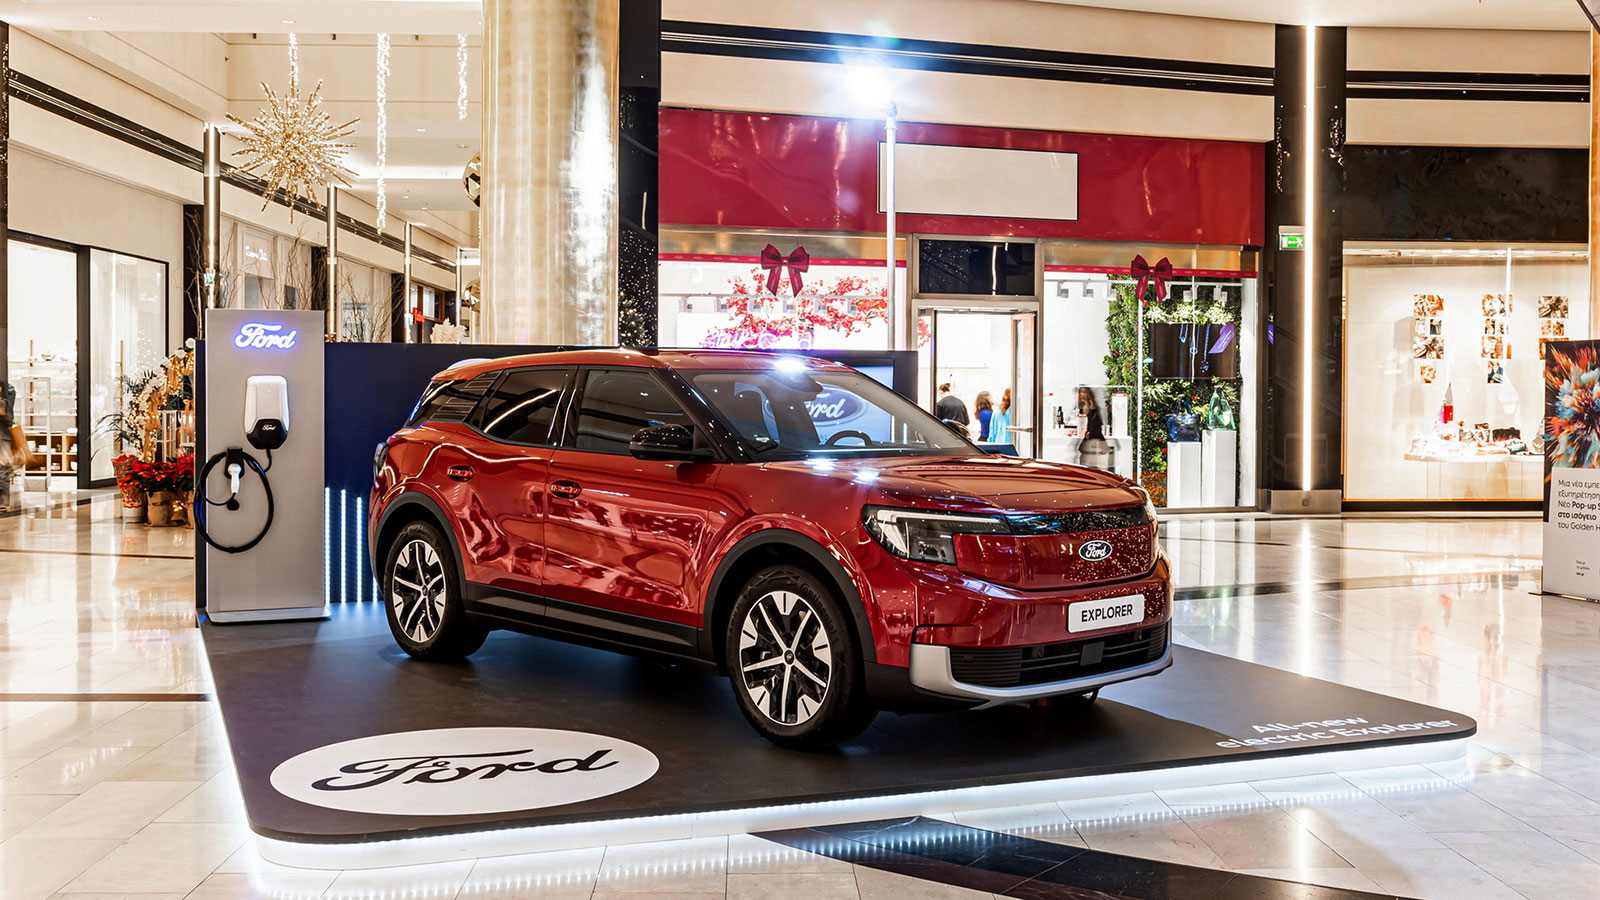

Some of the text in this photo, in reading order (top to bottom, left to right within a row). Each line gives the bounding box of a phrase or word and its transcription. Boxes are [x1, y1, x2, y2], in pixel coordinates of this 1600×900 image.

[235, 322, 297, 349] Ford
[1571, 501, 1597, 511] Pop-up
[1571, 512, 1597, 521] ισόγειο
[1570, 521, 1594, 531] Golden
[1085, 543, 1107, 558] Ford
[1081, 604, 1133, 622] EXPLORER
[1215, 718, 1458, 748] electric Explorer
[1252, 716, 1369, 733] All-new
[310, 748, 619, 792] Ford
